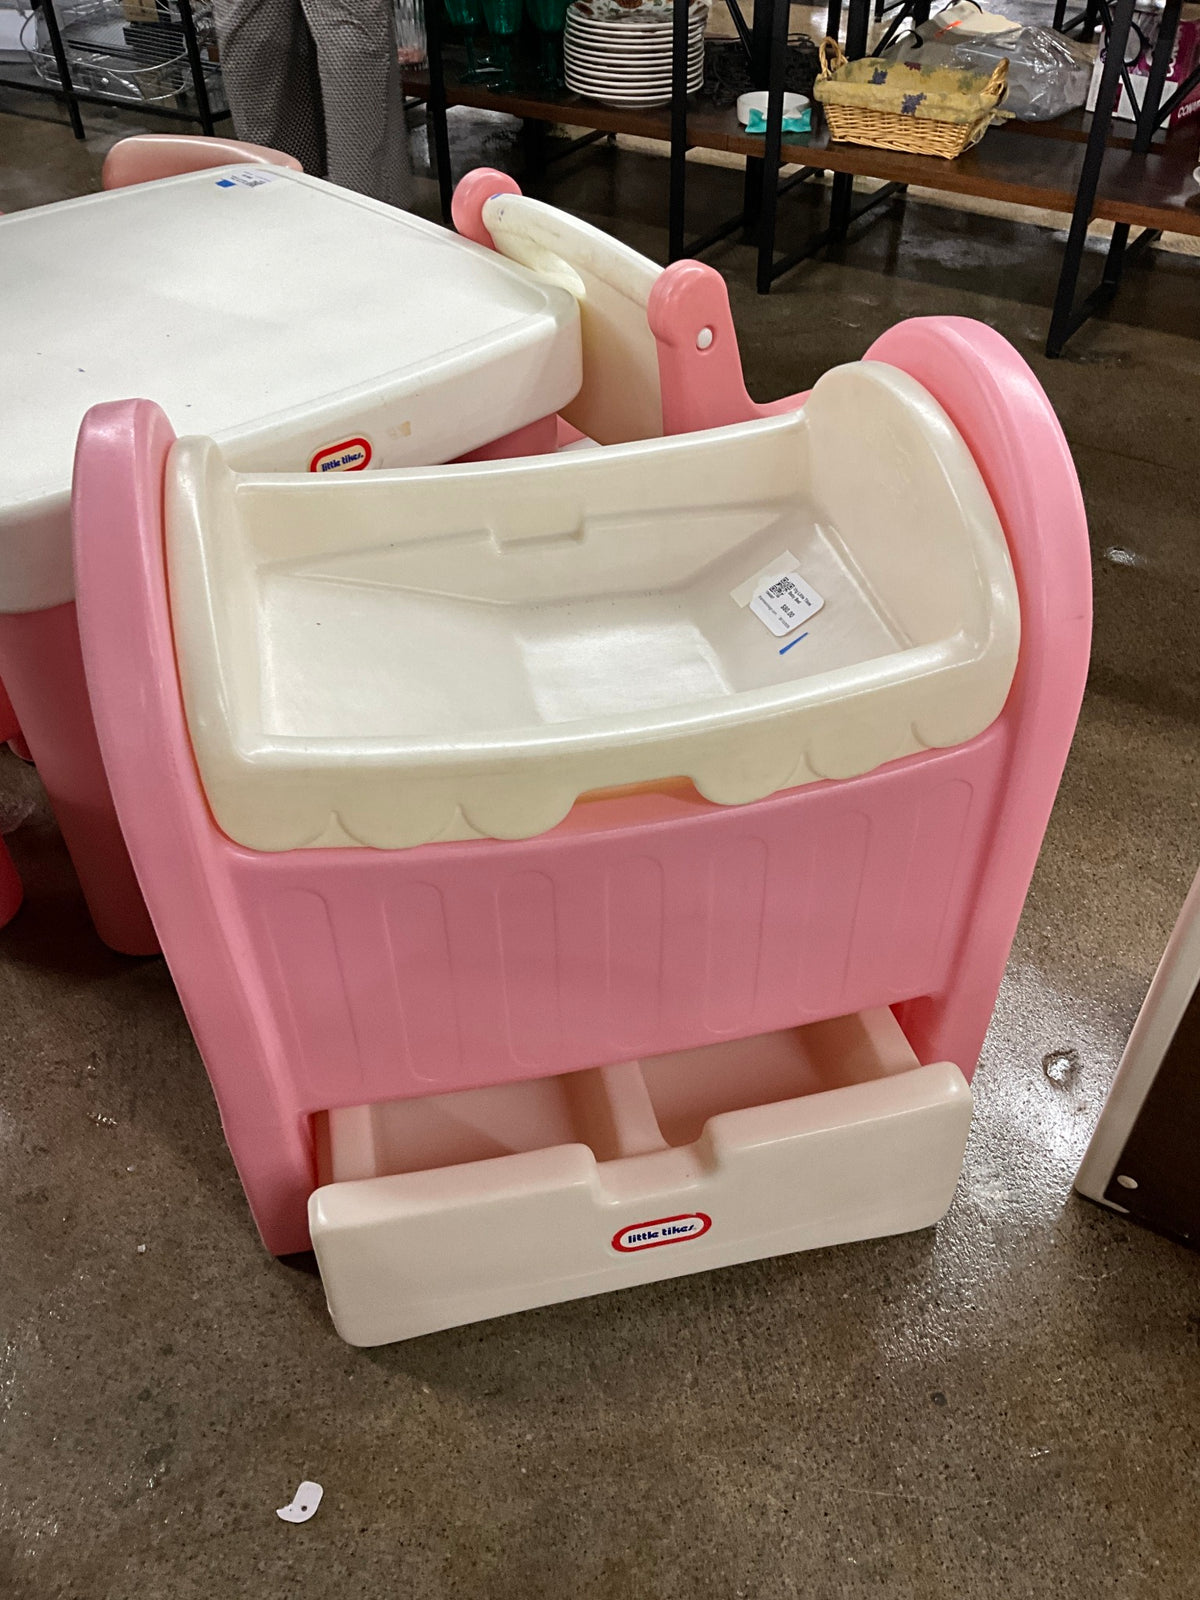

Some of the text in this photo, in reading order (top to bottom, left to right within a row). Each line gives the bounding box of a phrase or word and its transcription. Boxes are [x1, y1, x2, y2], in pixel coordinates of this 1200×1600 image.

[321, 459, 341, 472] little
[628, 1225, 695, 1243] little tikes
